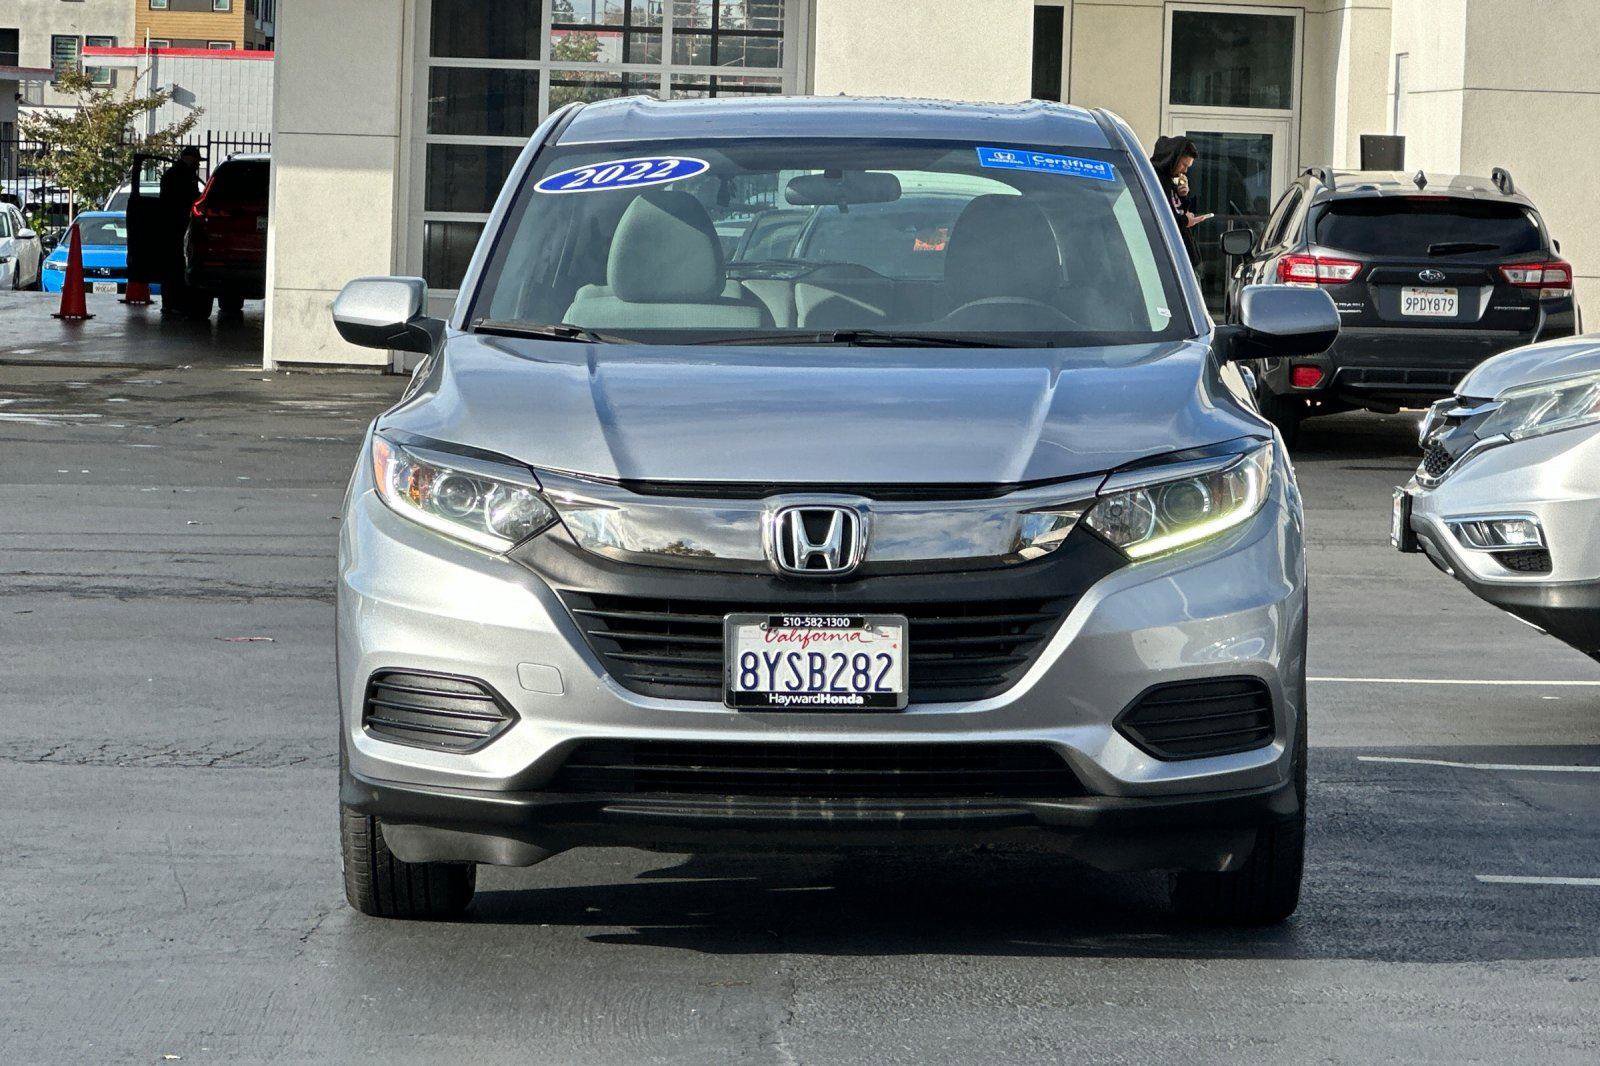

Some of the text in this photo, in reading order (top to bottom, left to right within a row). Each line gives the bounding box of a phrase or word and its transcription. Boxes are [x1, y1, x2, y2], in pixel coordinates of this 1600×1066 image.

[1032, 155, 1105, 171] Certified
[560, 159, 680, 190] 2022
[1405, 297, 1454, 312] 9PDY879
[782, 617, 851, 628] 510-582-1300
[765, 627, 873, 649] California
[739, 651, 893, 692] 8YSB282
